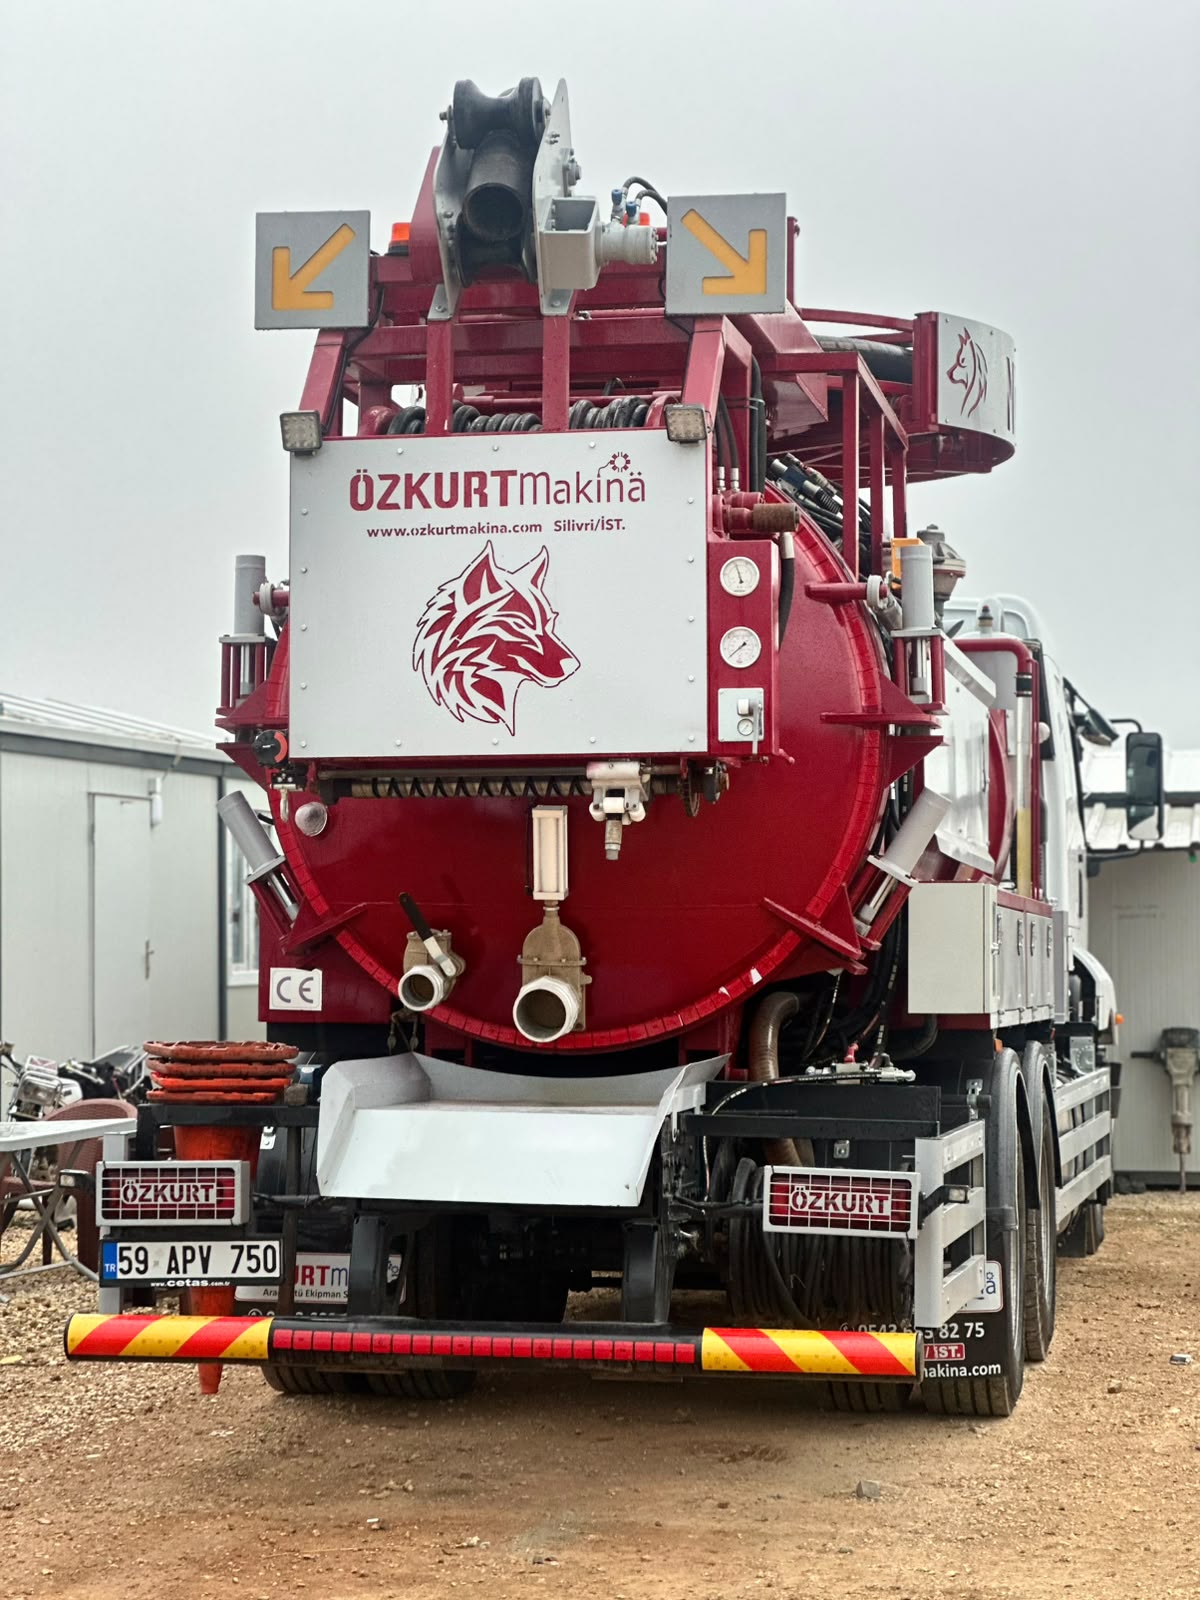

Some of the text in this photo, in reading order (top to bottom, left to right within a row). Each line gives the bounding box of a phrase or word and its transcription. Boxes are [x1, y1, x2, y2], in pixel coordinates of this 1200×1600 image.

[367, 516, 626, 538] www.ozkurtmakina.com Silivri/İST.
[276, 976, 314, 1004] CE
[122, 1180, 214, 1203] ÖZKURT
[791, 1187, 890, 1214] ÖZKURT
[105, 1264, 116, 1272] TR
[118, 1244, 277, 1275] 59 APV 750
[263, 1288, 277, 1297] Ara
[306, 1288, 341, 1299] Ekipman
[939, 1323, 960, 1338] 82
[964, 1322, 985, 1338] 75
